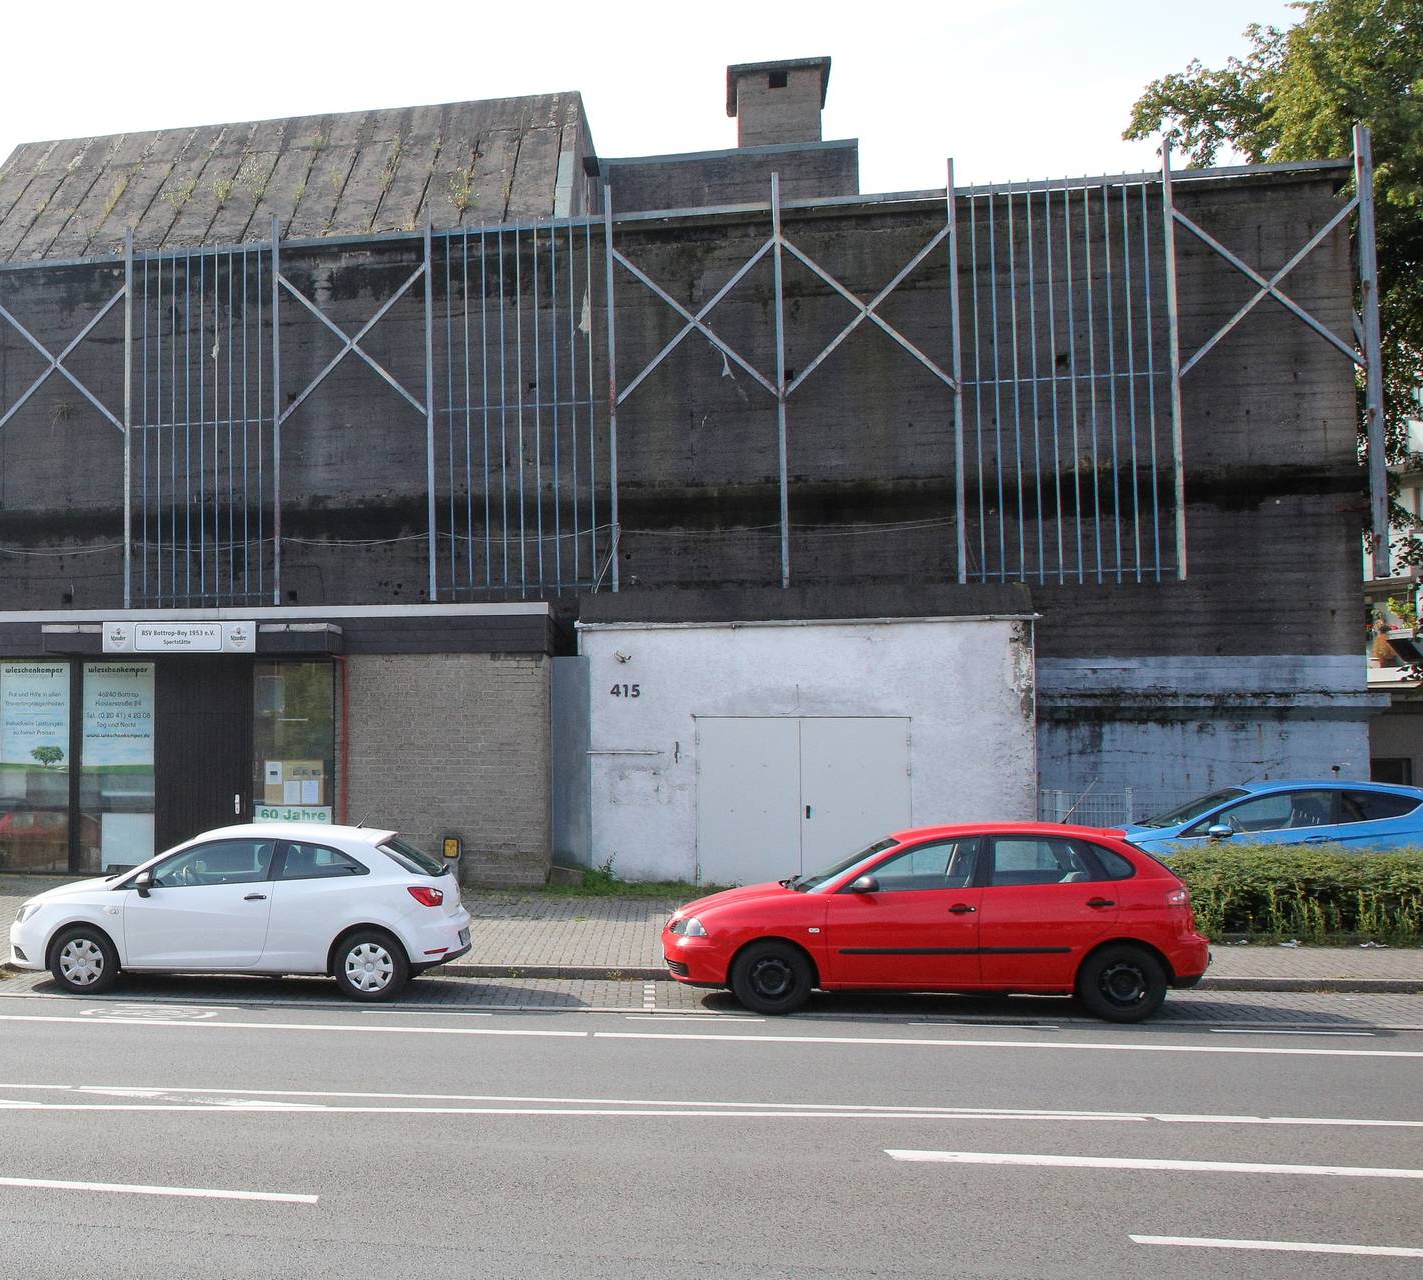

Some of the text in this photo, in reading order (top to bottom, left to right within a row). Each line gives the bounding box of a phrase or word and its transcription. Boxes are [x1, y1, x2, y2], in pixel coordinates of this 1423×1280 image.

[6, 666, 64, 678] wieschenkemper
[610, 684, 640, 698] 415
[260, 809, 326, 820] 60 Jahre
